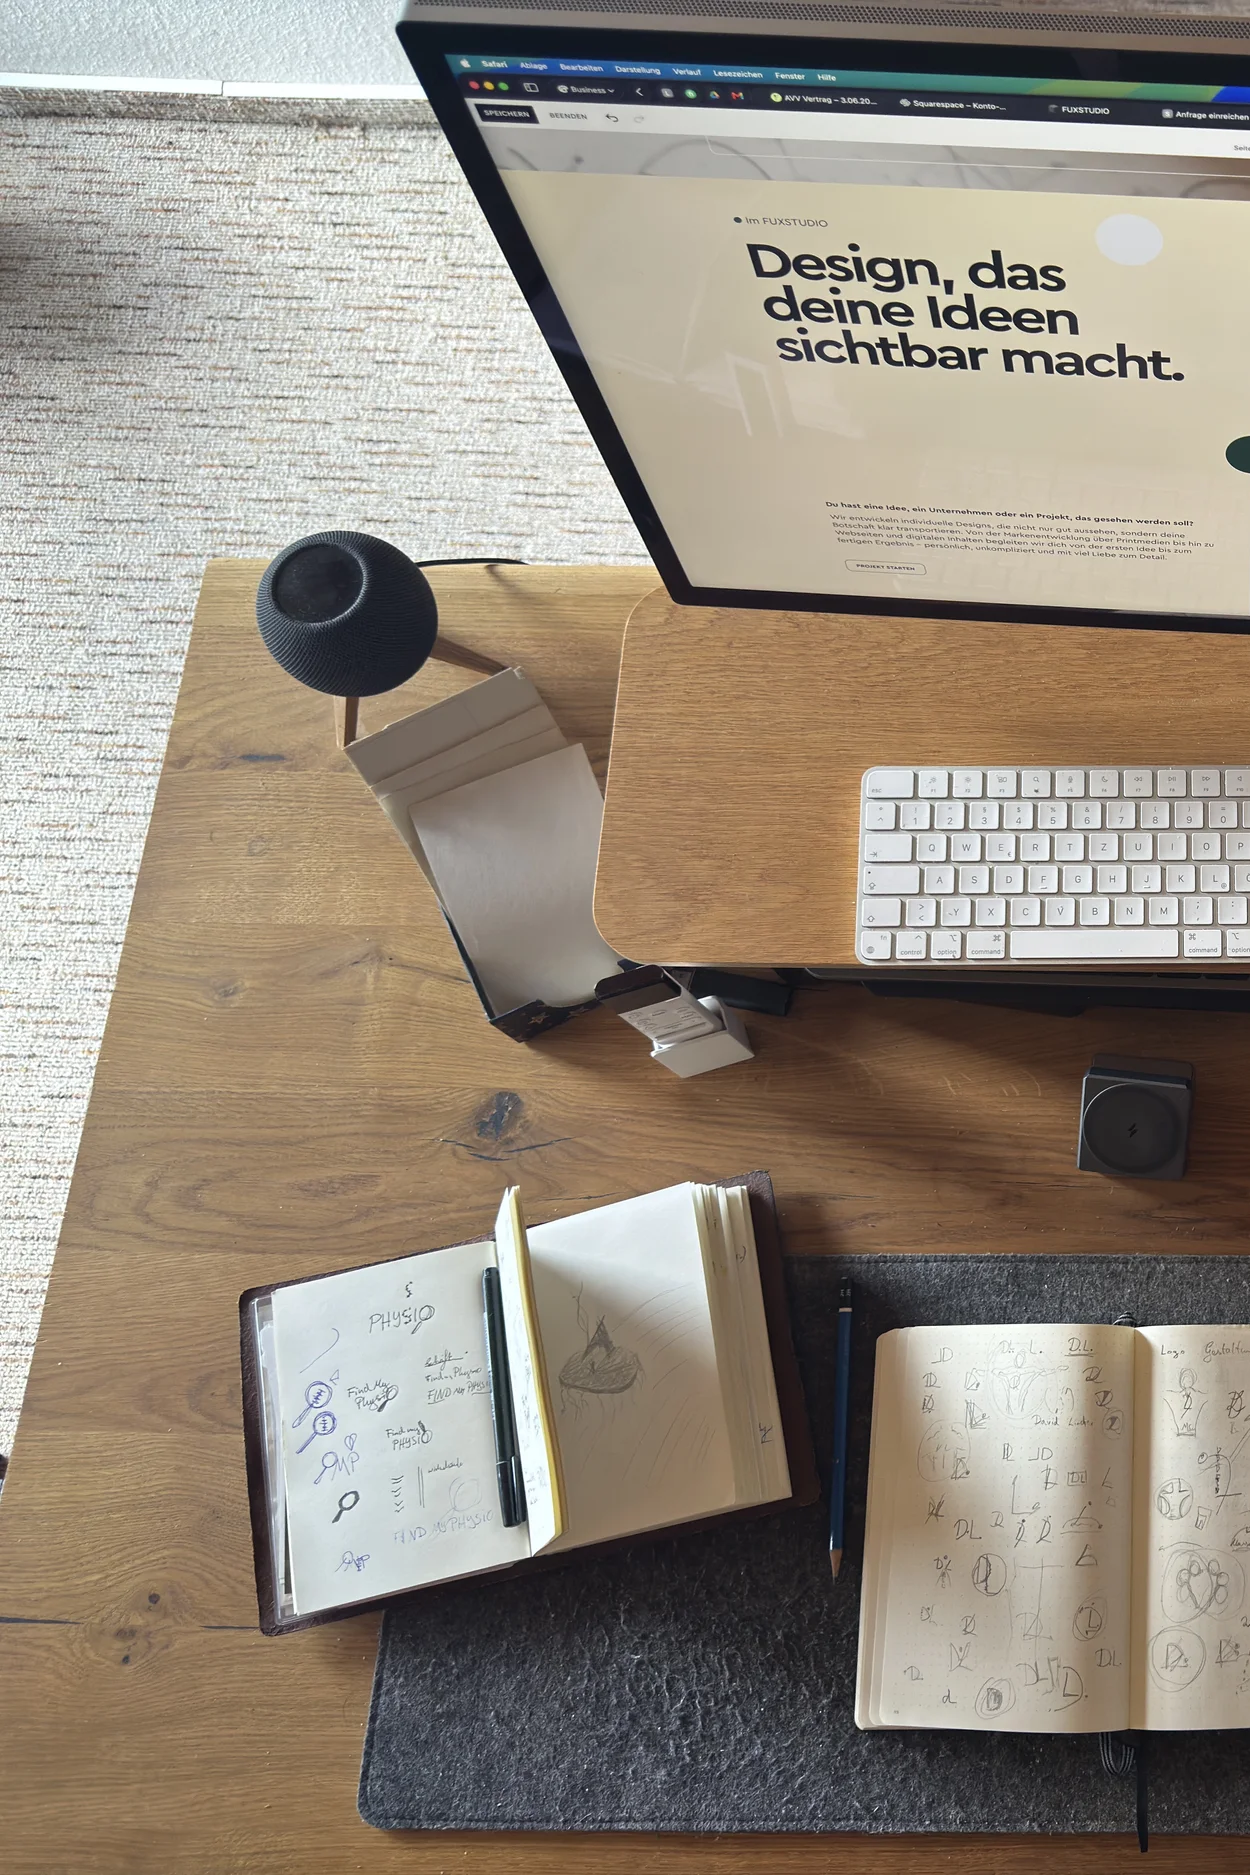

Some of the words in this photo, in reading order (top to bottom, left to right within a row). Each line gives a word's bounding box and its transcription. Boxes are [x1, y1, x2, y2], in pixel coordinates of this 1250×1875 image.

[481, 60, 507, 69] Safari
[520, 62, 548, 71] Ablage
[560, 63, 604, 72] Bearbeiten
[615, 65, 661, 75] Darstellung
[673, 68, 701, 76] Verlauf
[713, 69, 763, 79] Lesezeichen
[775, 72, 805, 81] Fenster
[817, 73, 837, 82] Hilfe
[571, 86, 606, 95] Business
[785, 94, 801, 102] AVV
[802, 95, 832, 104] Vertrag
[913, 100, 964, 110] Squarespace
[483, 109, 530, 118] SPEICHERN
[549, 112, 587, 121] BEENDEN
[1062, 106, 1110, 115] FUXSTUDIO
[1175, 111, 1207, 120] Anfrage
[1209, 113, 1249, 121] einreichen
[745, 216, 760, 226] Im
[762, 217, 828, 228] FUXSTUDIO
[746, 242, 954, 295] Design,
[968, 250, 1067, 292] das
[763, 285, 914, 328] deine
[927, 293, 1080, 336] Ideen
[776, 327, 988, 371] sichtbar
[1002, 343, 1185, 382] macht.
[840, 501, 861, 509] hast
[885, 504, 910, 513] Idee,
[928, 507, 992, 516] Unternehmen
[1036, 512, 1072, 521] Projekt,
[832, 521, 875, 529] Botschaft
[896, 525, 963, 534] transportieren.
[1003, 531, 1090, 542] Markenentwicklung
[1116, 537, 1170, 545] Printmedien
[900, 517, 953, 526] individuelle
[955, 521, 994, 529] Designs,
[1073, 528, 1118, 536] aussehen,
[834, 529, 883, 537] Webseiten
[905, 533, 945, 541] digitalen
[985, 537, 1028, 545] begleiten
[837, 536, 873, 545] fertigen
[874, 539, 914, 547] Ergebnis
[924, 542, 973, 551] persönlich,
[975, 545, 1035, 554] unkompliziert
[937, 949, 957, 957] option
[971, 948, 1001, 956] command
[1160, 1344, 1186, 1360] Logo
